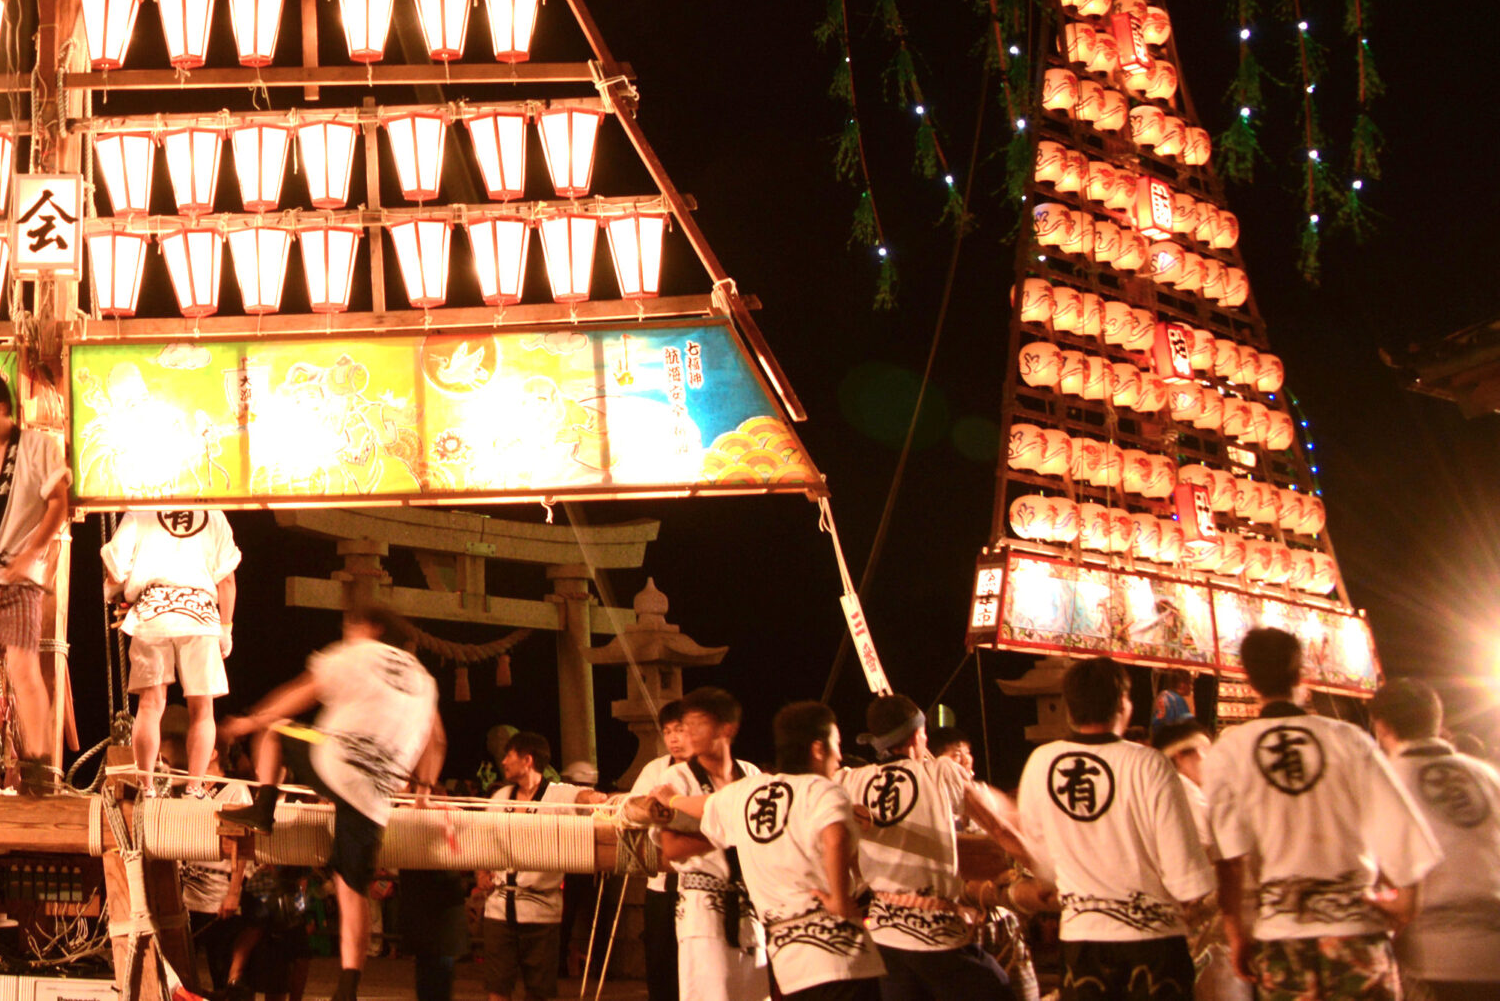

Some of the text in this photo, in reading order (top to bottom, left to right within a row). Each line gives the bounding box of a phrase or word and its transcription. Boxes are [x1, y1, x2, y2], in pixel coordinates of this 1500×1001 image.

[16, 189, 78, 253] 会
[687, 342, 702, 386] 七福神
[665, 347, 688, 454] 航海安全
[1261, 732, 1308, 783] 有
[750, 786, 784, 834] 有
[870, 771, 907, 821] 有
[1056, 757, 1101, 813] 有
